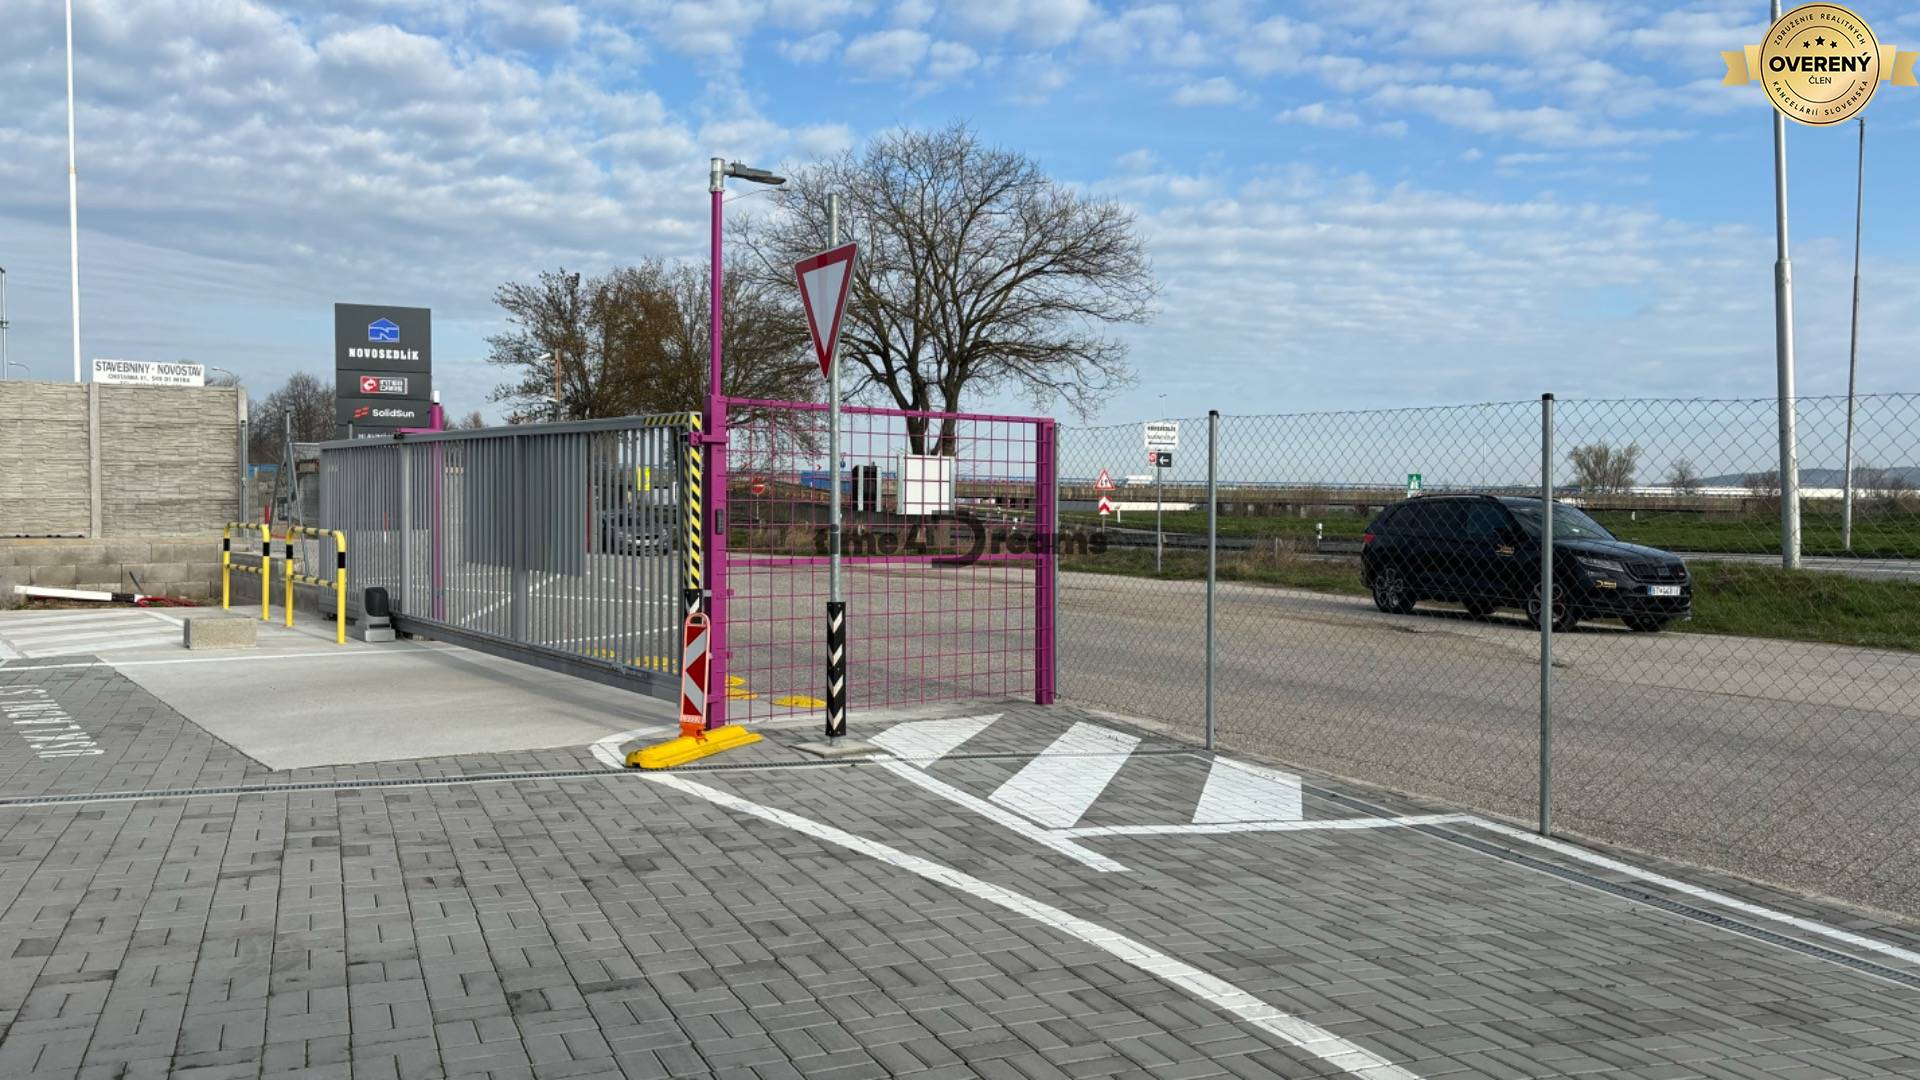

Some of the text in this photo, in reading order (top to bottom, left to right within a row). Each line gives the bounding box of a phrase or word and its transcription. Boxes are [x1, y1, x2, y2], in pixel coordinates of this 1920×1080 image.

[95, 360, 151, 374] STAVEBNINY
[157, 364, 202, 377] NOVOSTAV
[372, 408, 415, 419] SolidSun
